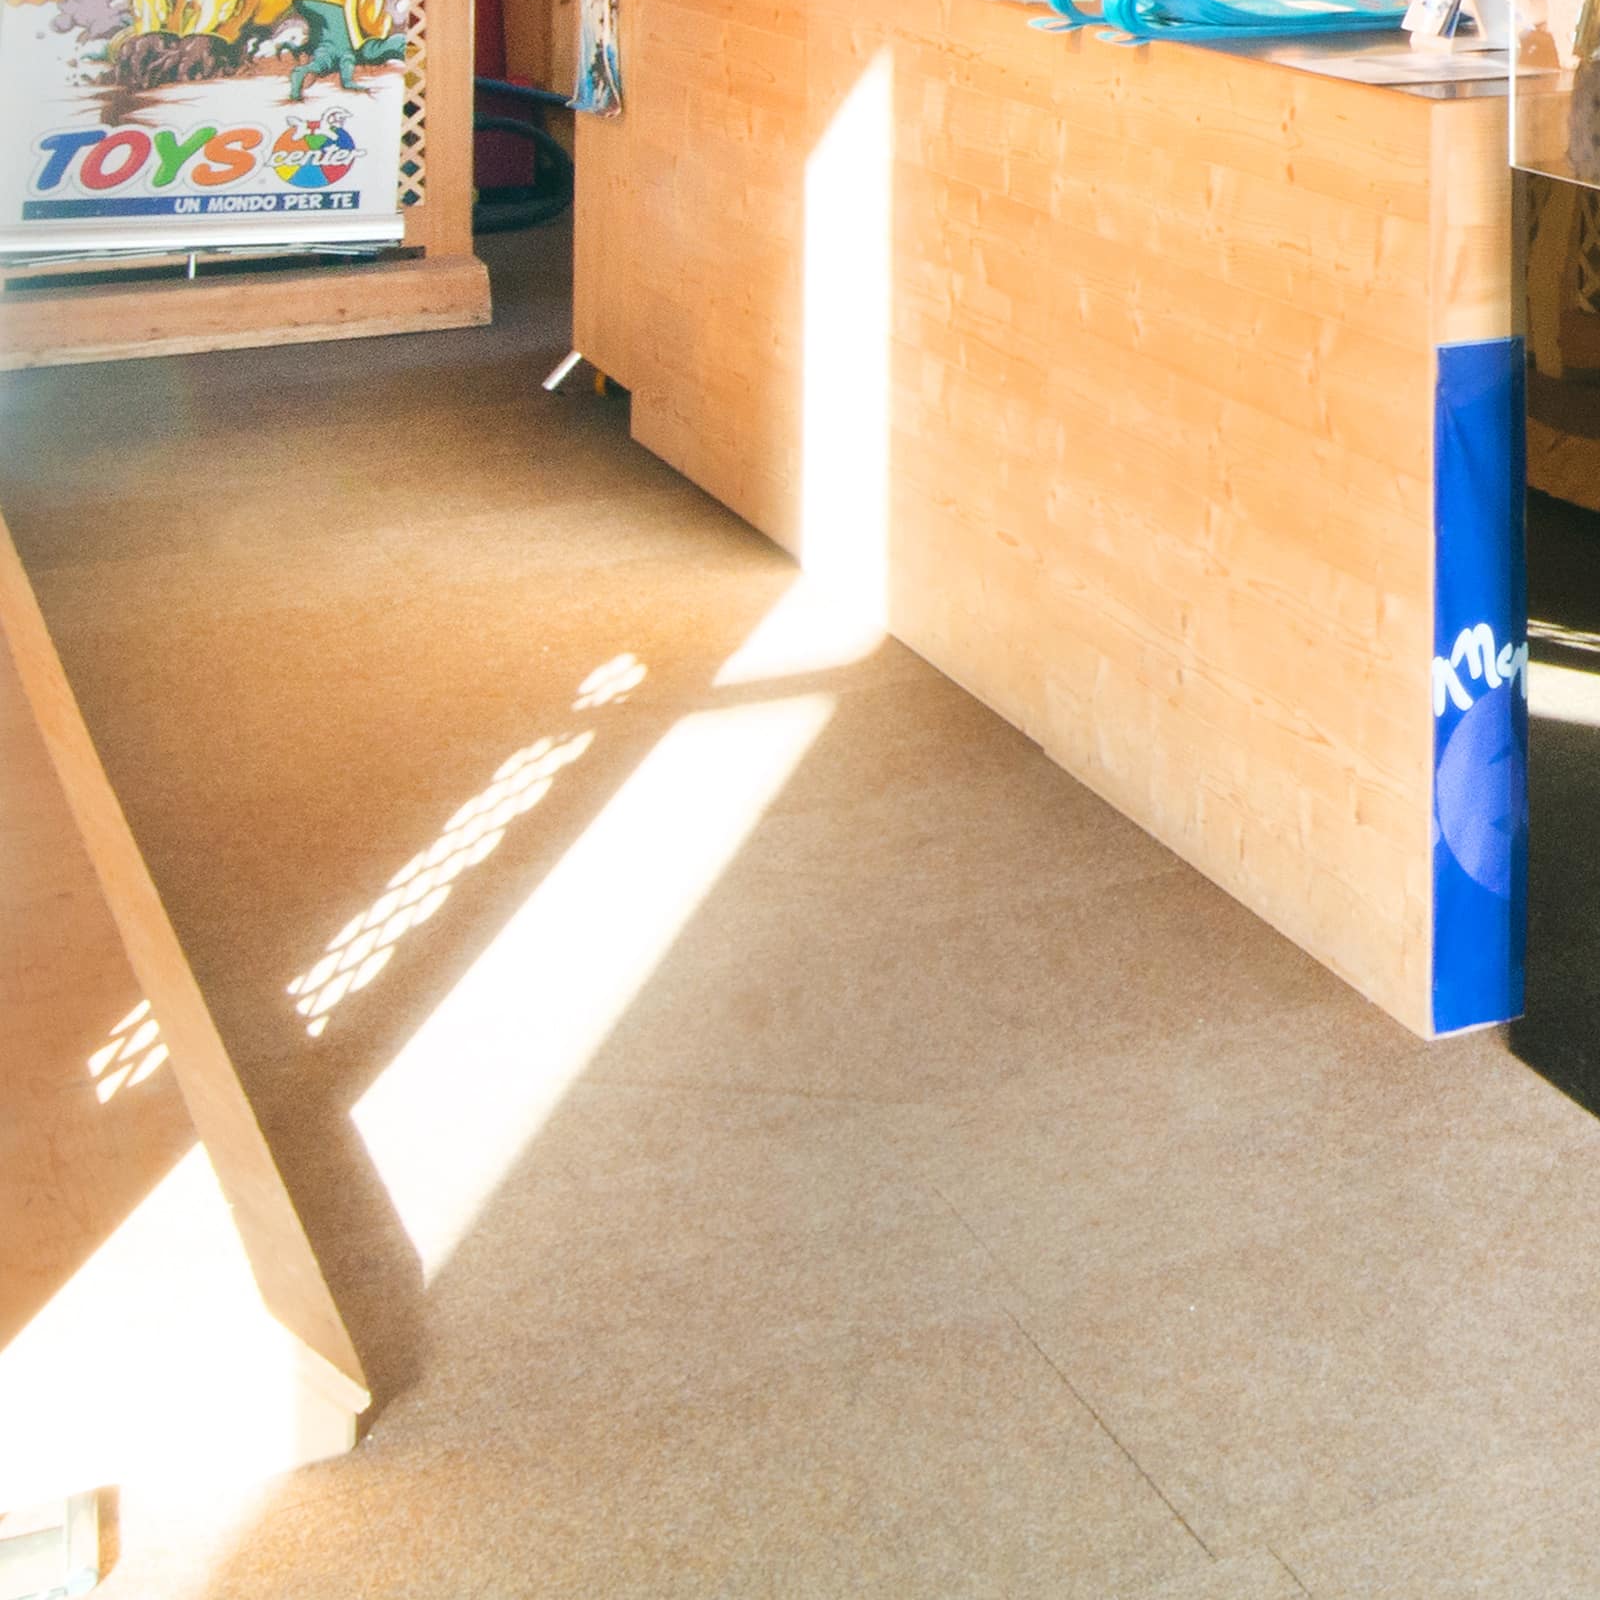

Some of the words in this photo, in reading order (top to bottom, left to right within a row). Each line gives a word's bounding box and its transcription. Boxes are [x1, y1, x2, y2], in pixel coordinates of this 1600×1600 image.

[37, 125, 263, 191] TOYS
[265, 144, 368, 172] center
[174, 197, 201, 214] UN
[206, 195, 277, 213] MONDO
[283, 193, 324, 211] PER
[331, 191, 354, 209] TE
